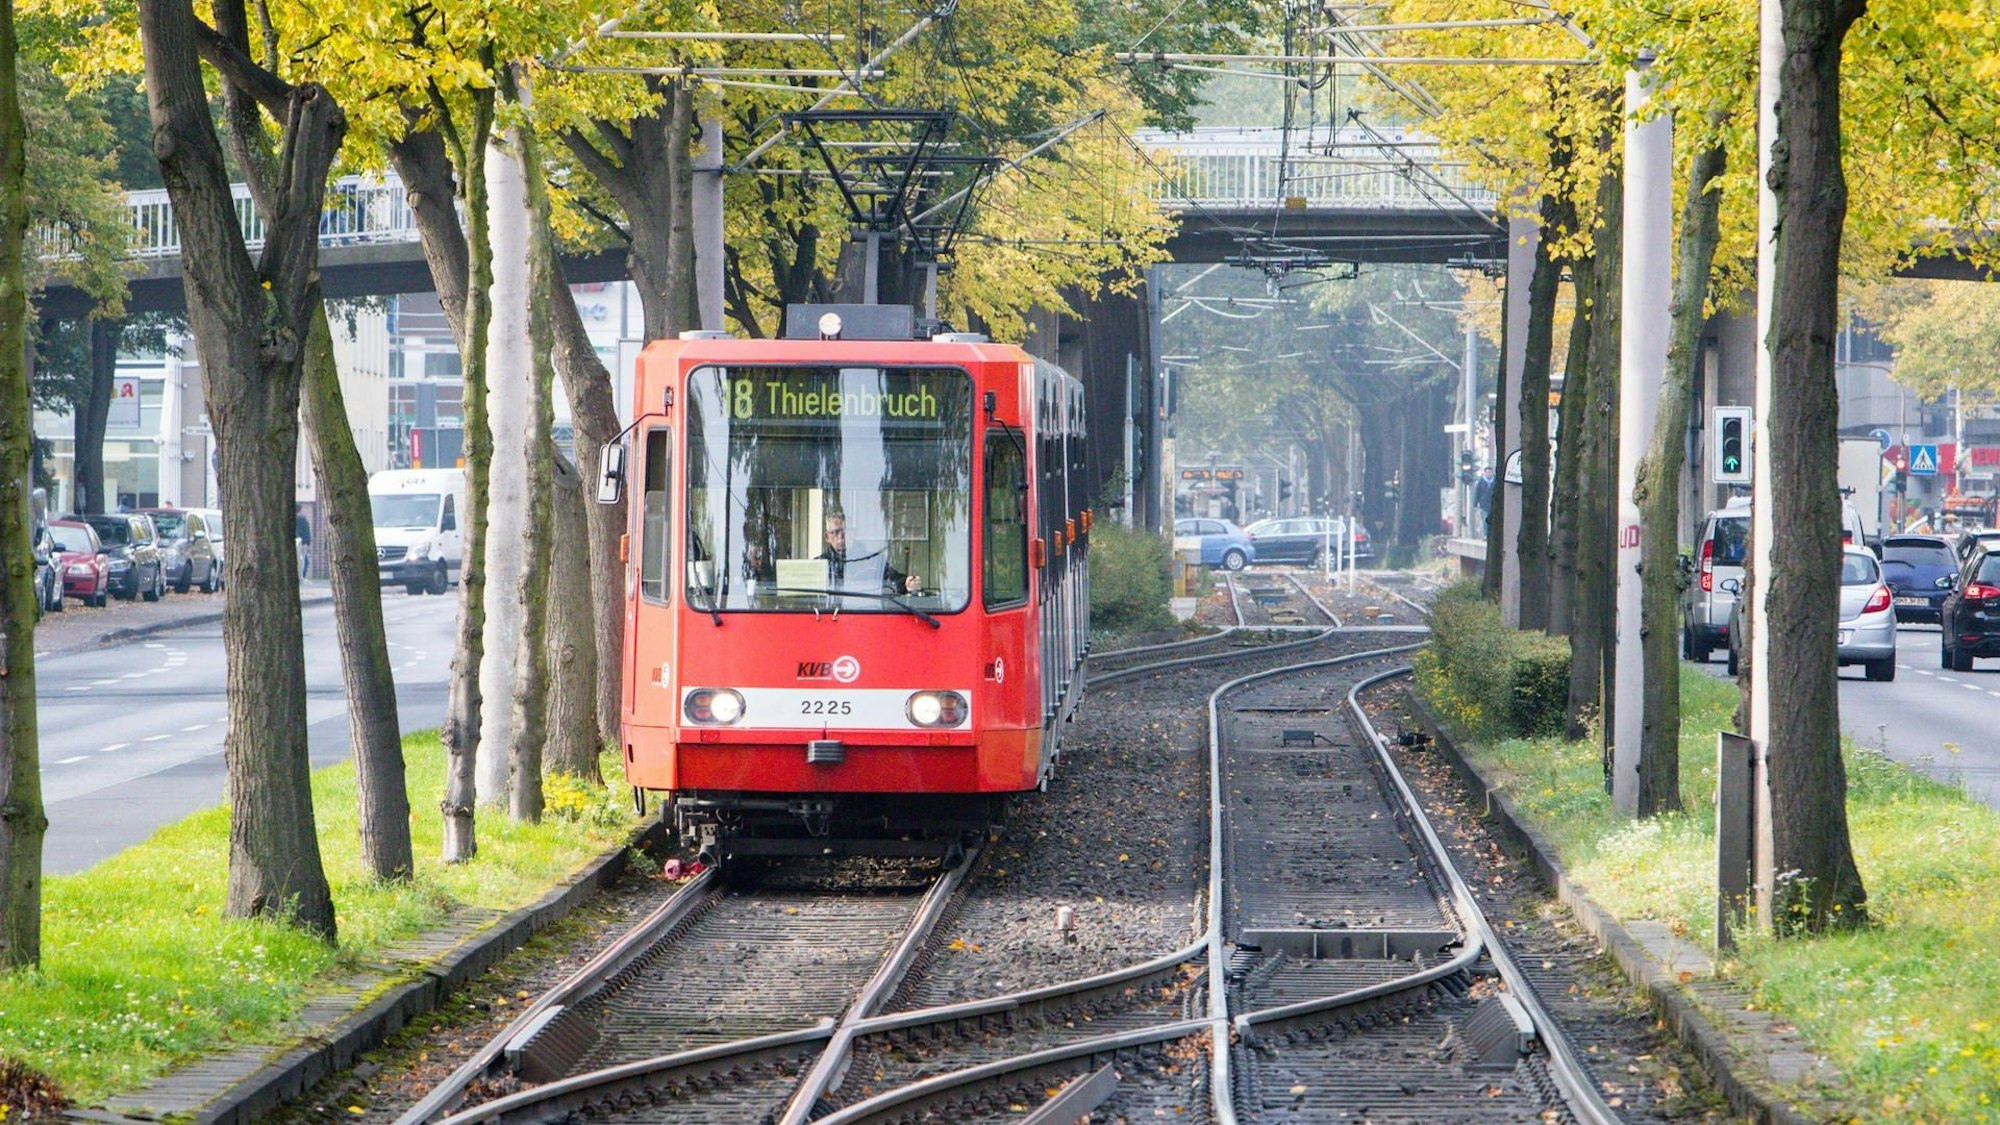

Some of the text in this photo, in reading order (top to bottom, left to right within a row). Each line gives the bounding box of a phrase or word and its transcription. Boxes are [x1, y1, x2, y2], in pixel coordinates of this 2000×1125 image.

[724, 378, 937, 419] 18 Thielenbruch
[797, 662, 832, 677] KVB
[801, 700, 852, 715] 2225
